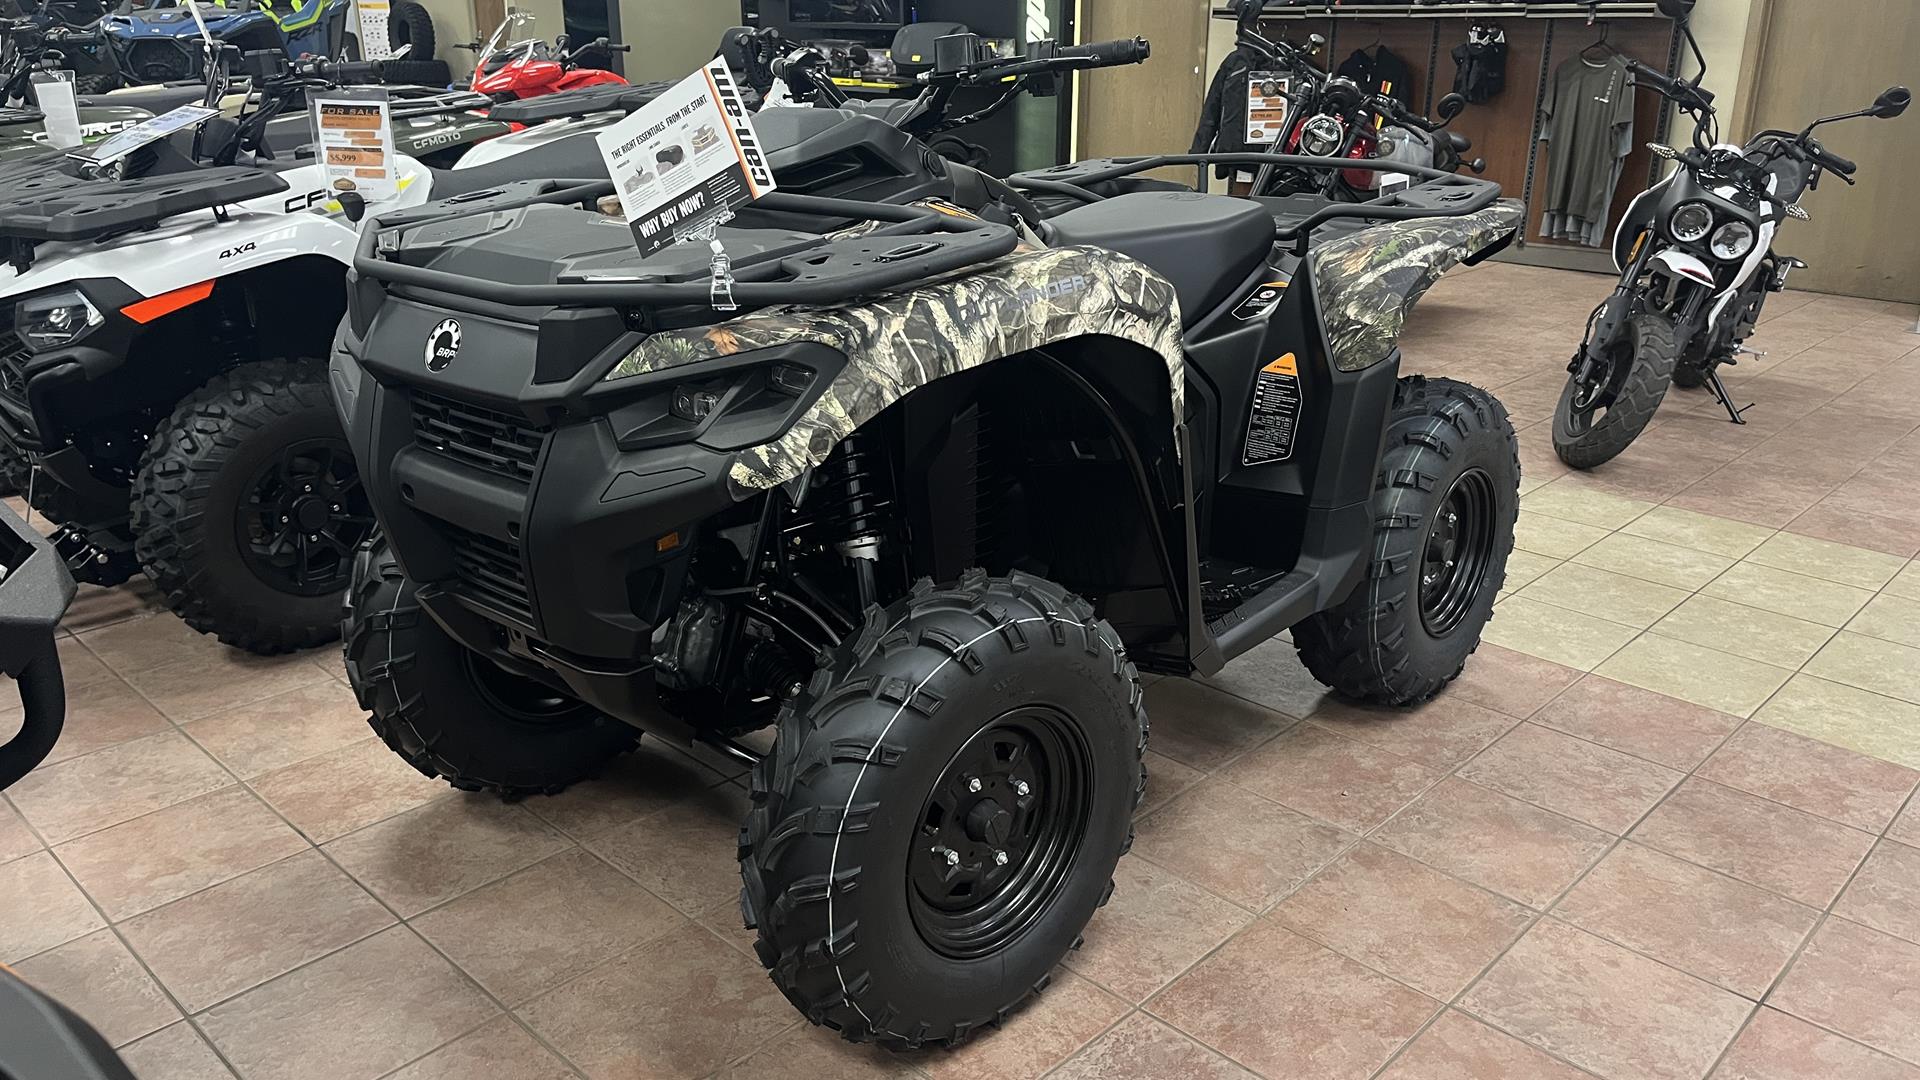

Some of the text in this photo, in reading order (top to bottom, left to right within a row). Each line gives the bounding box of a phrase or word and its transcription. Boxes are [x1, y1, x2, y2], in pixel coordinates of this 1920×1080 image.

[321, 107, 380, 116] FOR SALE
[710, 67, 770, 187] can-am
[413, 132, 461, 149] CFMOTO
[611, 147, 622, 159] THE
[621, 138, 638, 156] RIGHT
[666, 112, 681, 127] FROM
[681, 104, 691, 119] THE
[639, 215, 662, 239] WHY
[660, 206, 680, 228] BUY
[678, 192, 707, 219] NOW?
[436, 347, 455, 358] BRP
